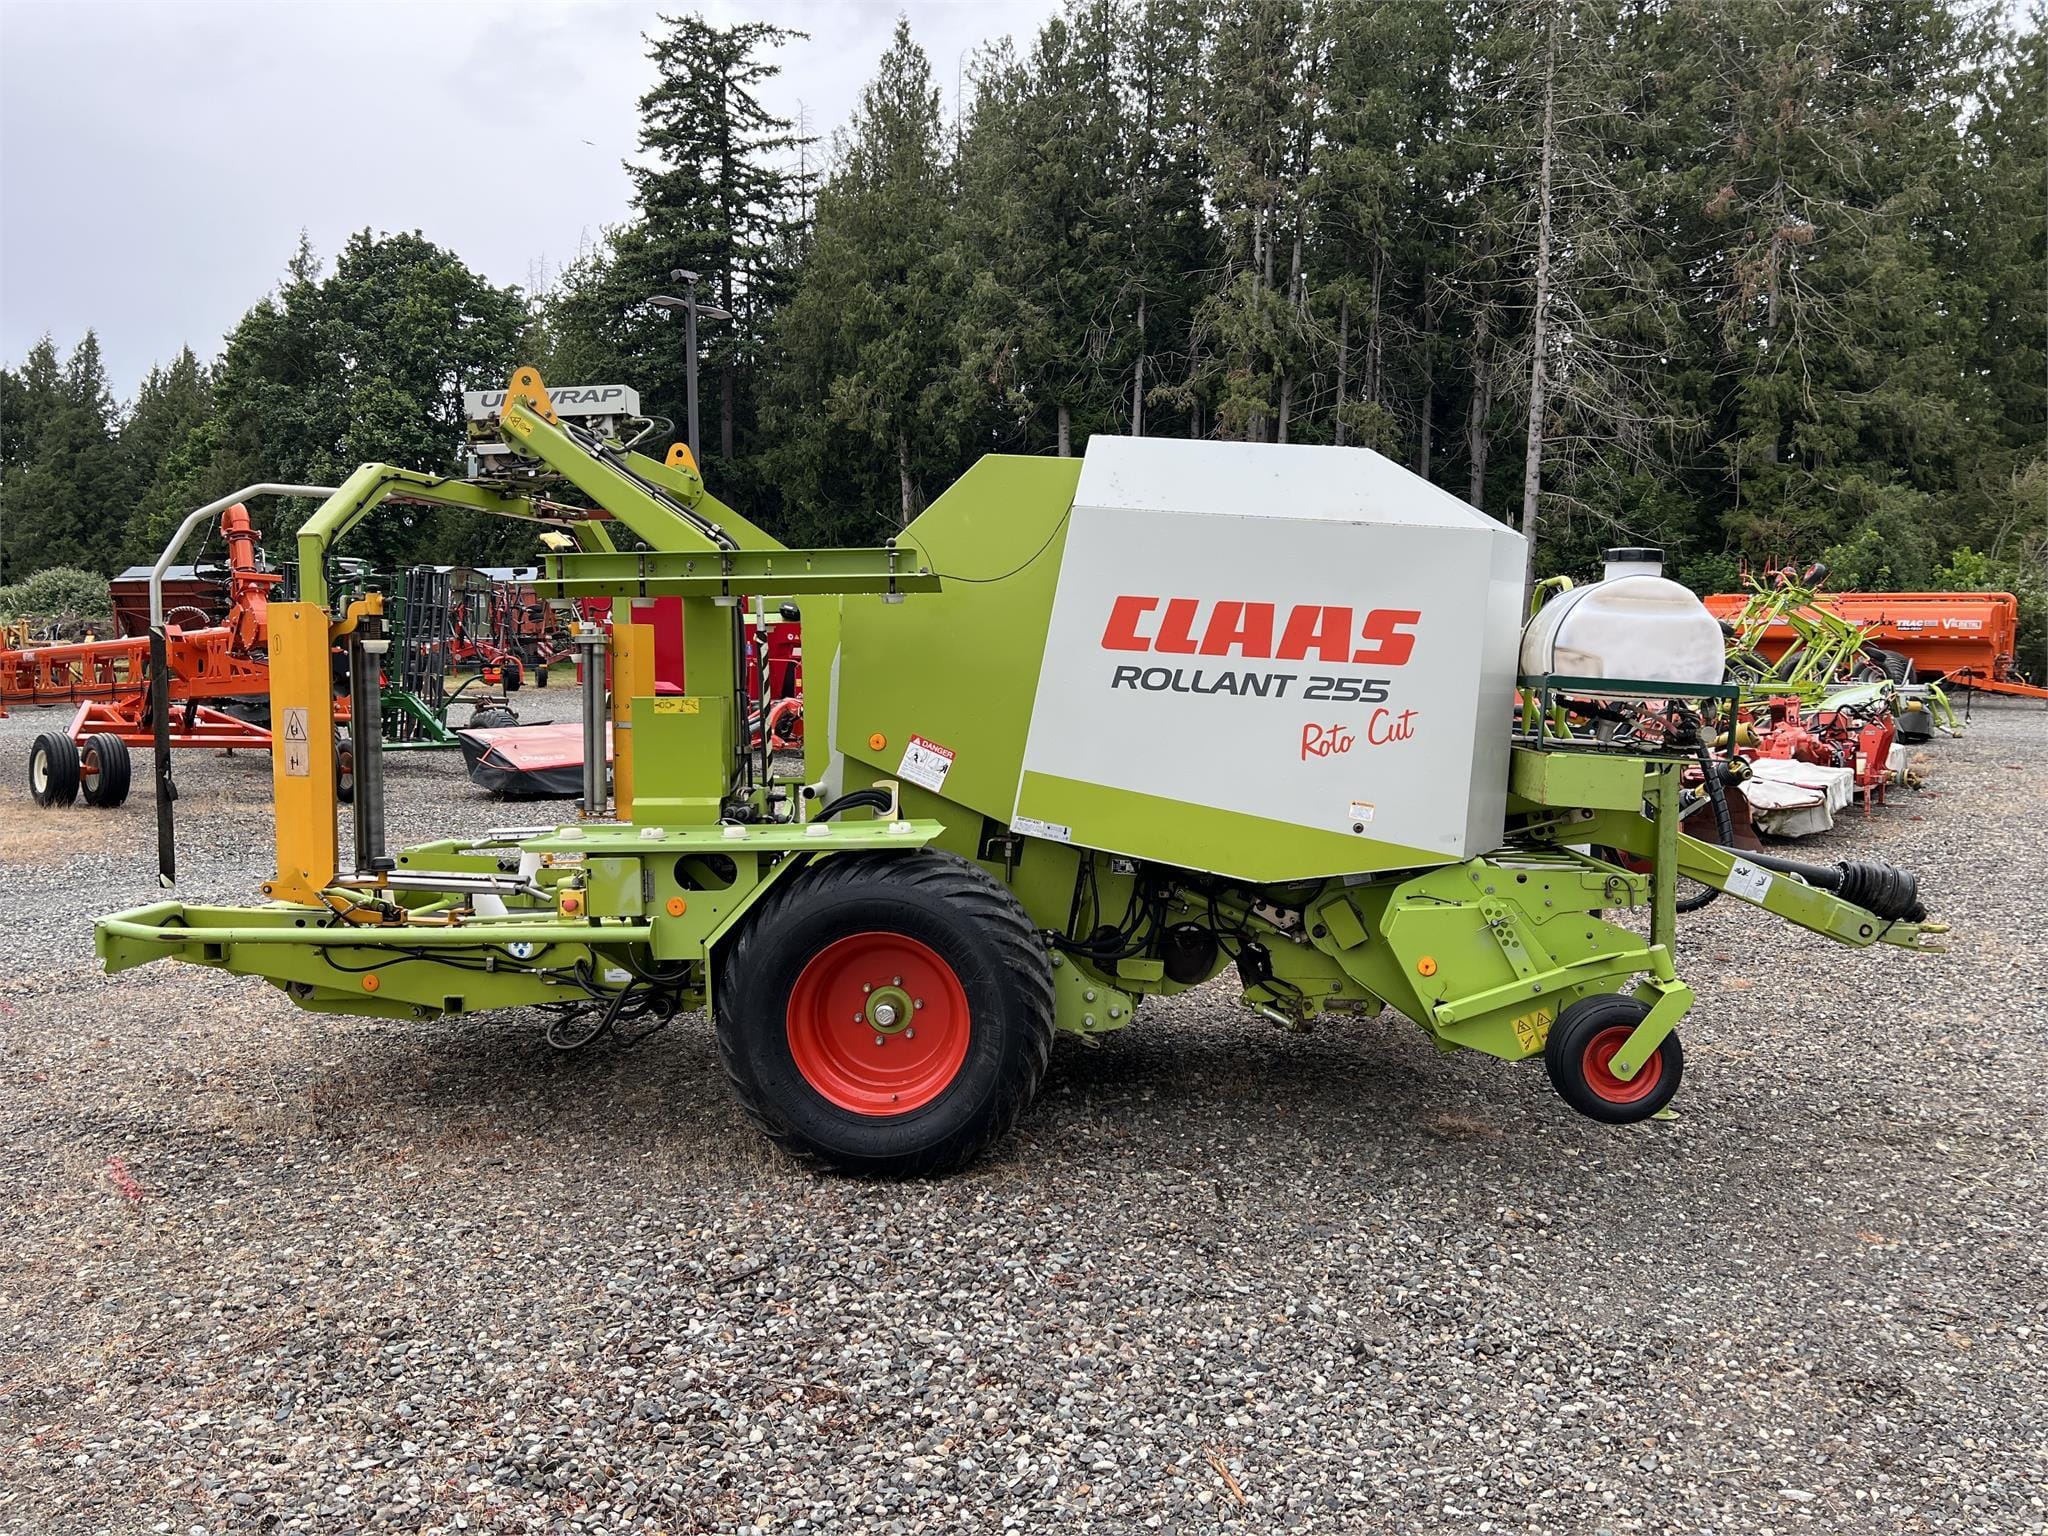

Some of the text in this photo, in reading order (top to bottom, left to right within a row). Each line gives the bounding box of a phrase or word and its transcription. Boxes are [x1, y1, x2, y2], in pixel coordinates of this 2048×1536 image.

[1101, 595, 1422, 666] CLAAS
[1110, 665, 1392, 704] ROLLANT 255
[921, 740, 954, 759] DANGER
[1301, 708, 1419, 761] Roto Cut
